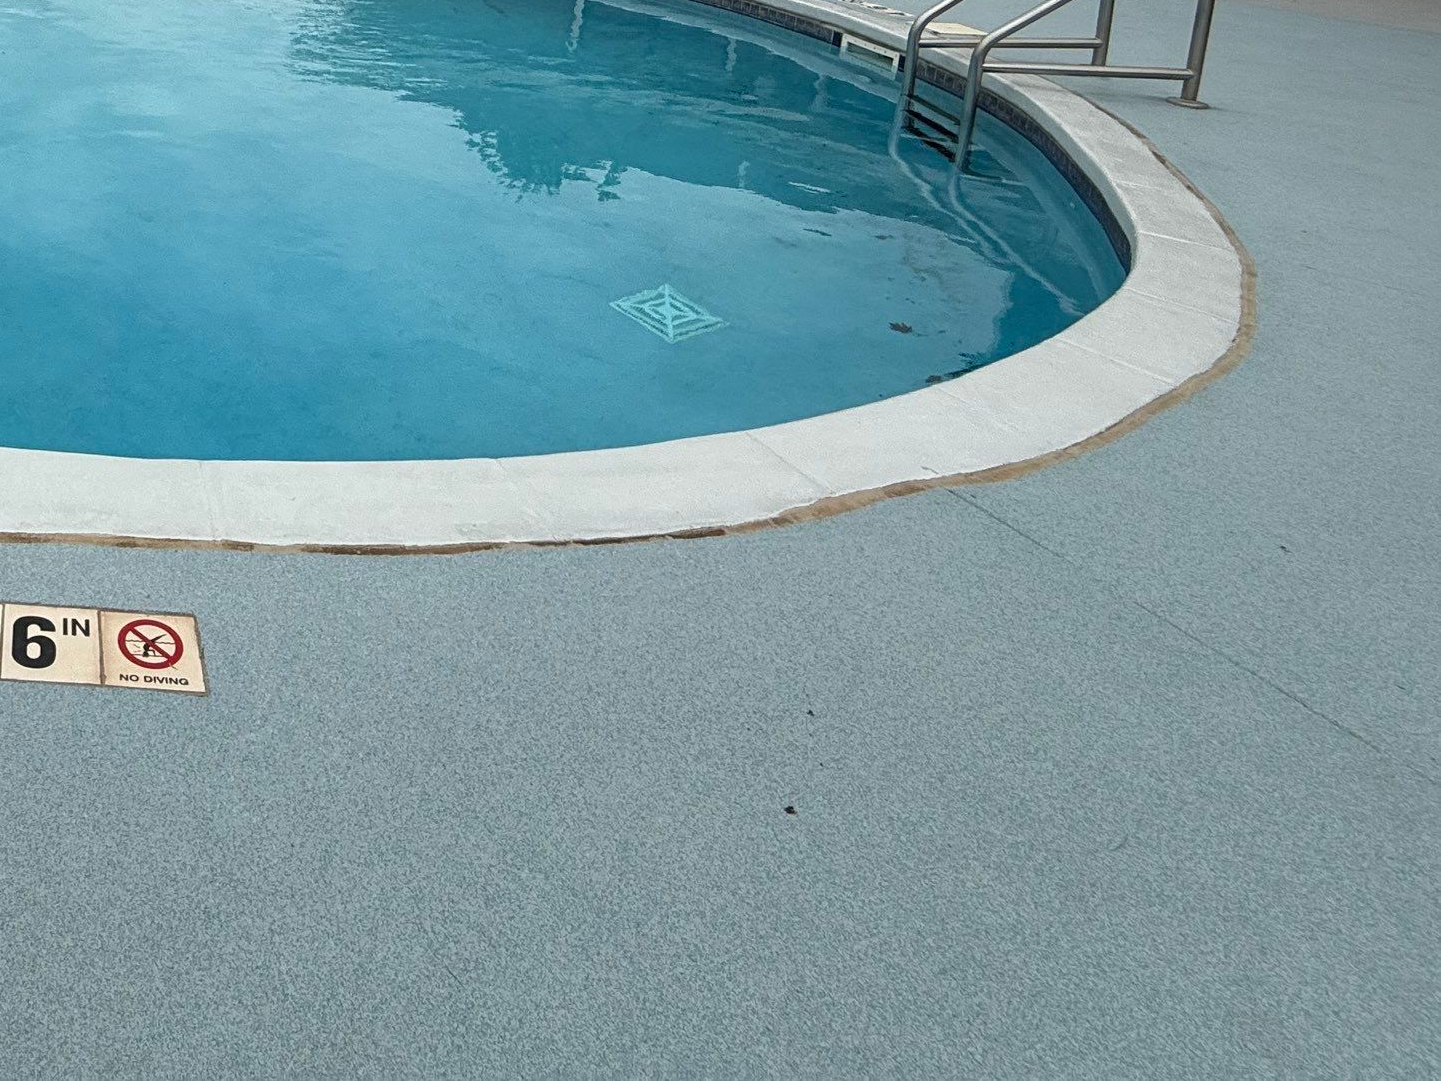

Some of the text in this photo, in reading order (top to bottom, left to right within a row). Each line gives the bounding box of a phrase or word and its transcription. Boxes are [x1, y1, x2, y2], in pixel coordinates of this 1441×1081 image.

[11, 615, 57, 669] 6
[62, 617, 91, 637] IN
[119, 673, 189, 686] NO DIVING
